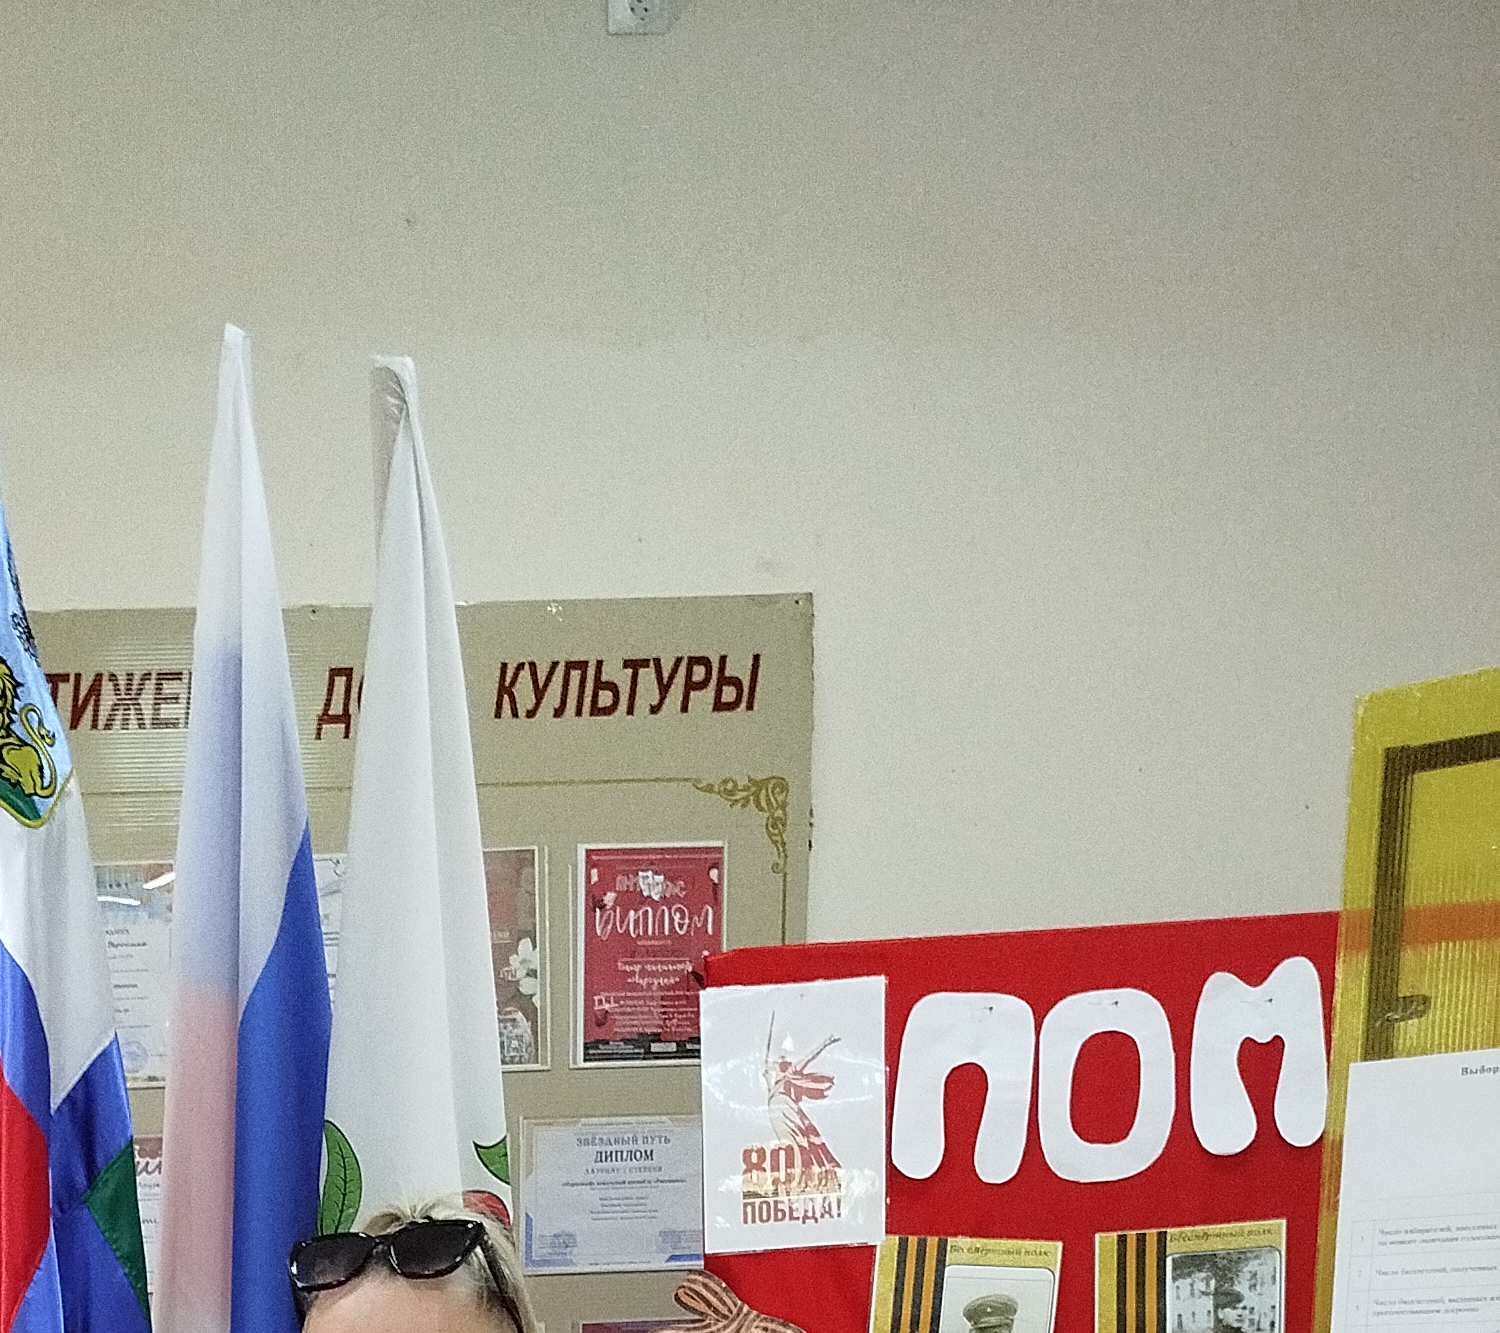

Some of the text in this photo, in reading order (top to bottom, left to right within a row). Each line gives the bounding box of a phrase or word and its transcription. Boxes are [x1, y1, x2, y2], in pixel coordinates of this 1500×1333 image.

[315, 667, 365, 740] Д
[493, 653, 761, 720] КУЛЬТУРЫ
[892, 956, 1329, 1183] ПОМ
[642, 1135, 671, 1145] ПУТЬ
[594, 1149, 654, 1163] ДИПЛОМ
[742, 1197, 841, 1224] ПОБЕДА!
